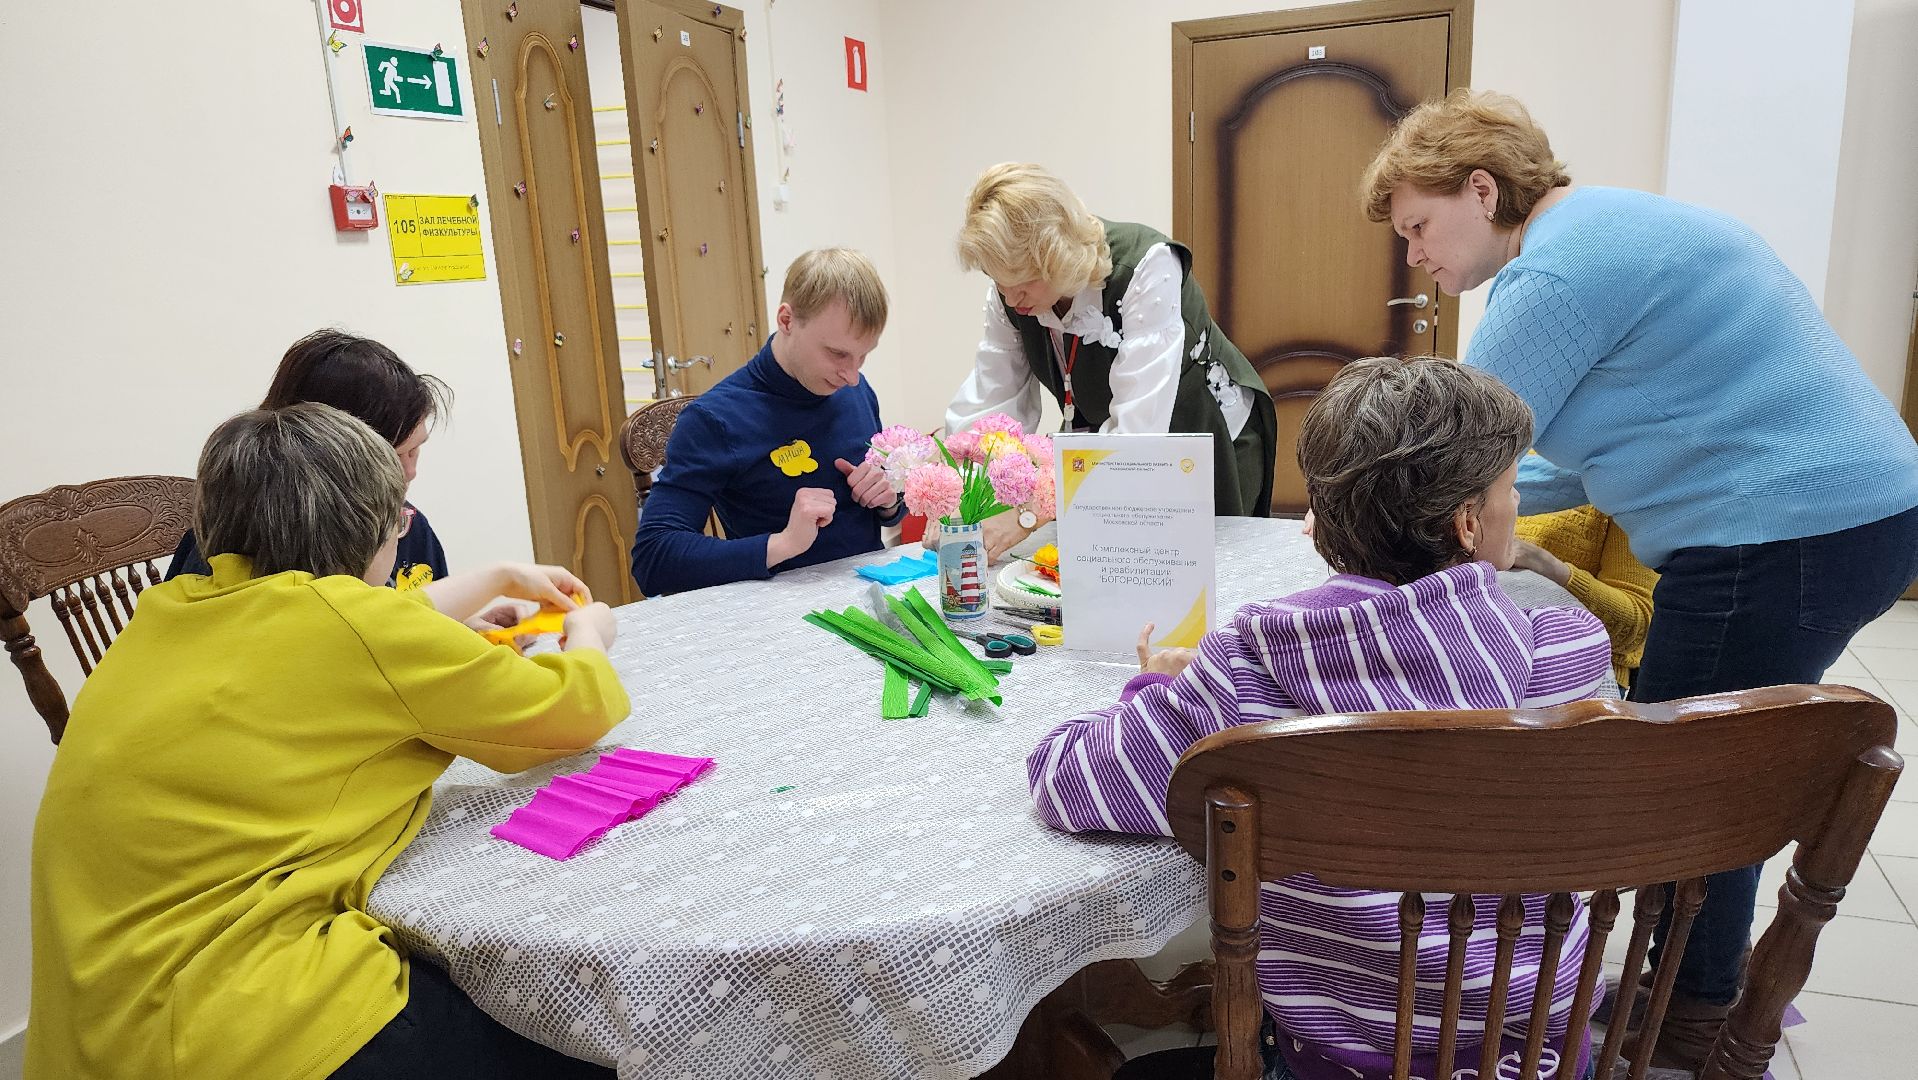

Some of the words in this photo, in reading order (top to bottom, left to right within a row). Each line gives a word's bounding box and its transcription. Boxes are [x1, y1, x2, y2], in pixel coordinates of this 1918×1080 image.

[419, 216, 435, 225] ЗАЛ
[437, 214, 478, 225] ЛЕЧЕБНОЙ
[393, 219, 416, 234] 105
[422, 227, 478, 237] ФИЗКУЛЬТУРЫ
[1092, 543, 1151, 554] Комплексный
[1154, 548, 1180, 557] центр
[1076, 555, 1131, 564] социального
[1133, 556, 1197, 567] обслуживания
[1109, 566, 1171, 576] реабилитации
